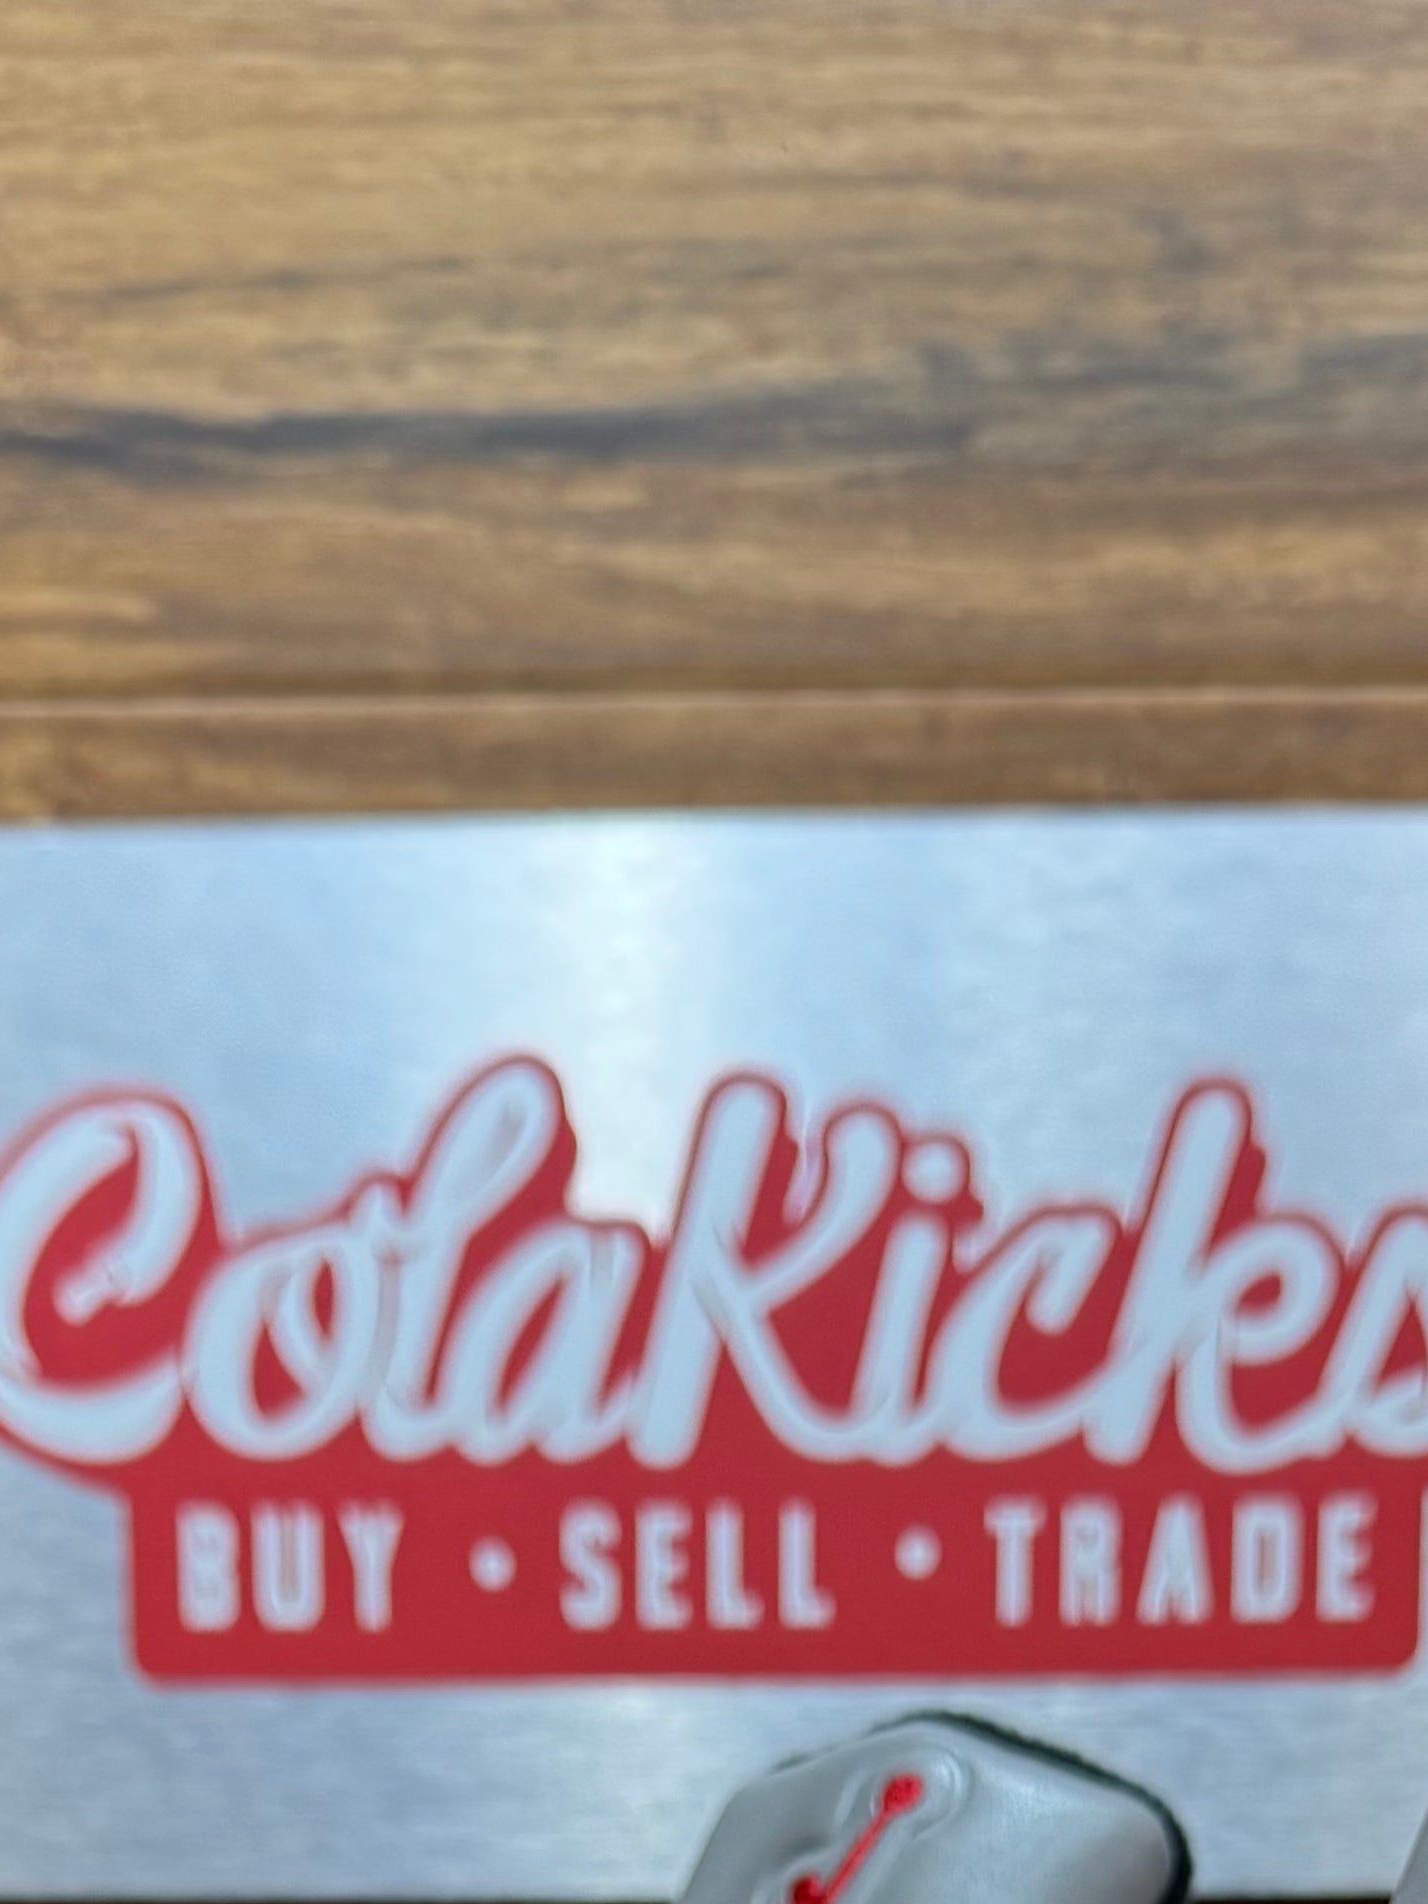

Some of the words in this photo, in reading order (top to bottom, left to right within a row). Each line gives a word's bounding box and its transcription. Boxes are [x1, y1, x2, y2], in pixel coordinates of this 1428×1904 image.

[176, 1504, 404, 1632] BUY
[558, 1502, 833, 1630] SELL
[984, 1495, 1373, 1626] TRADE
